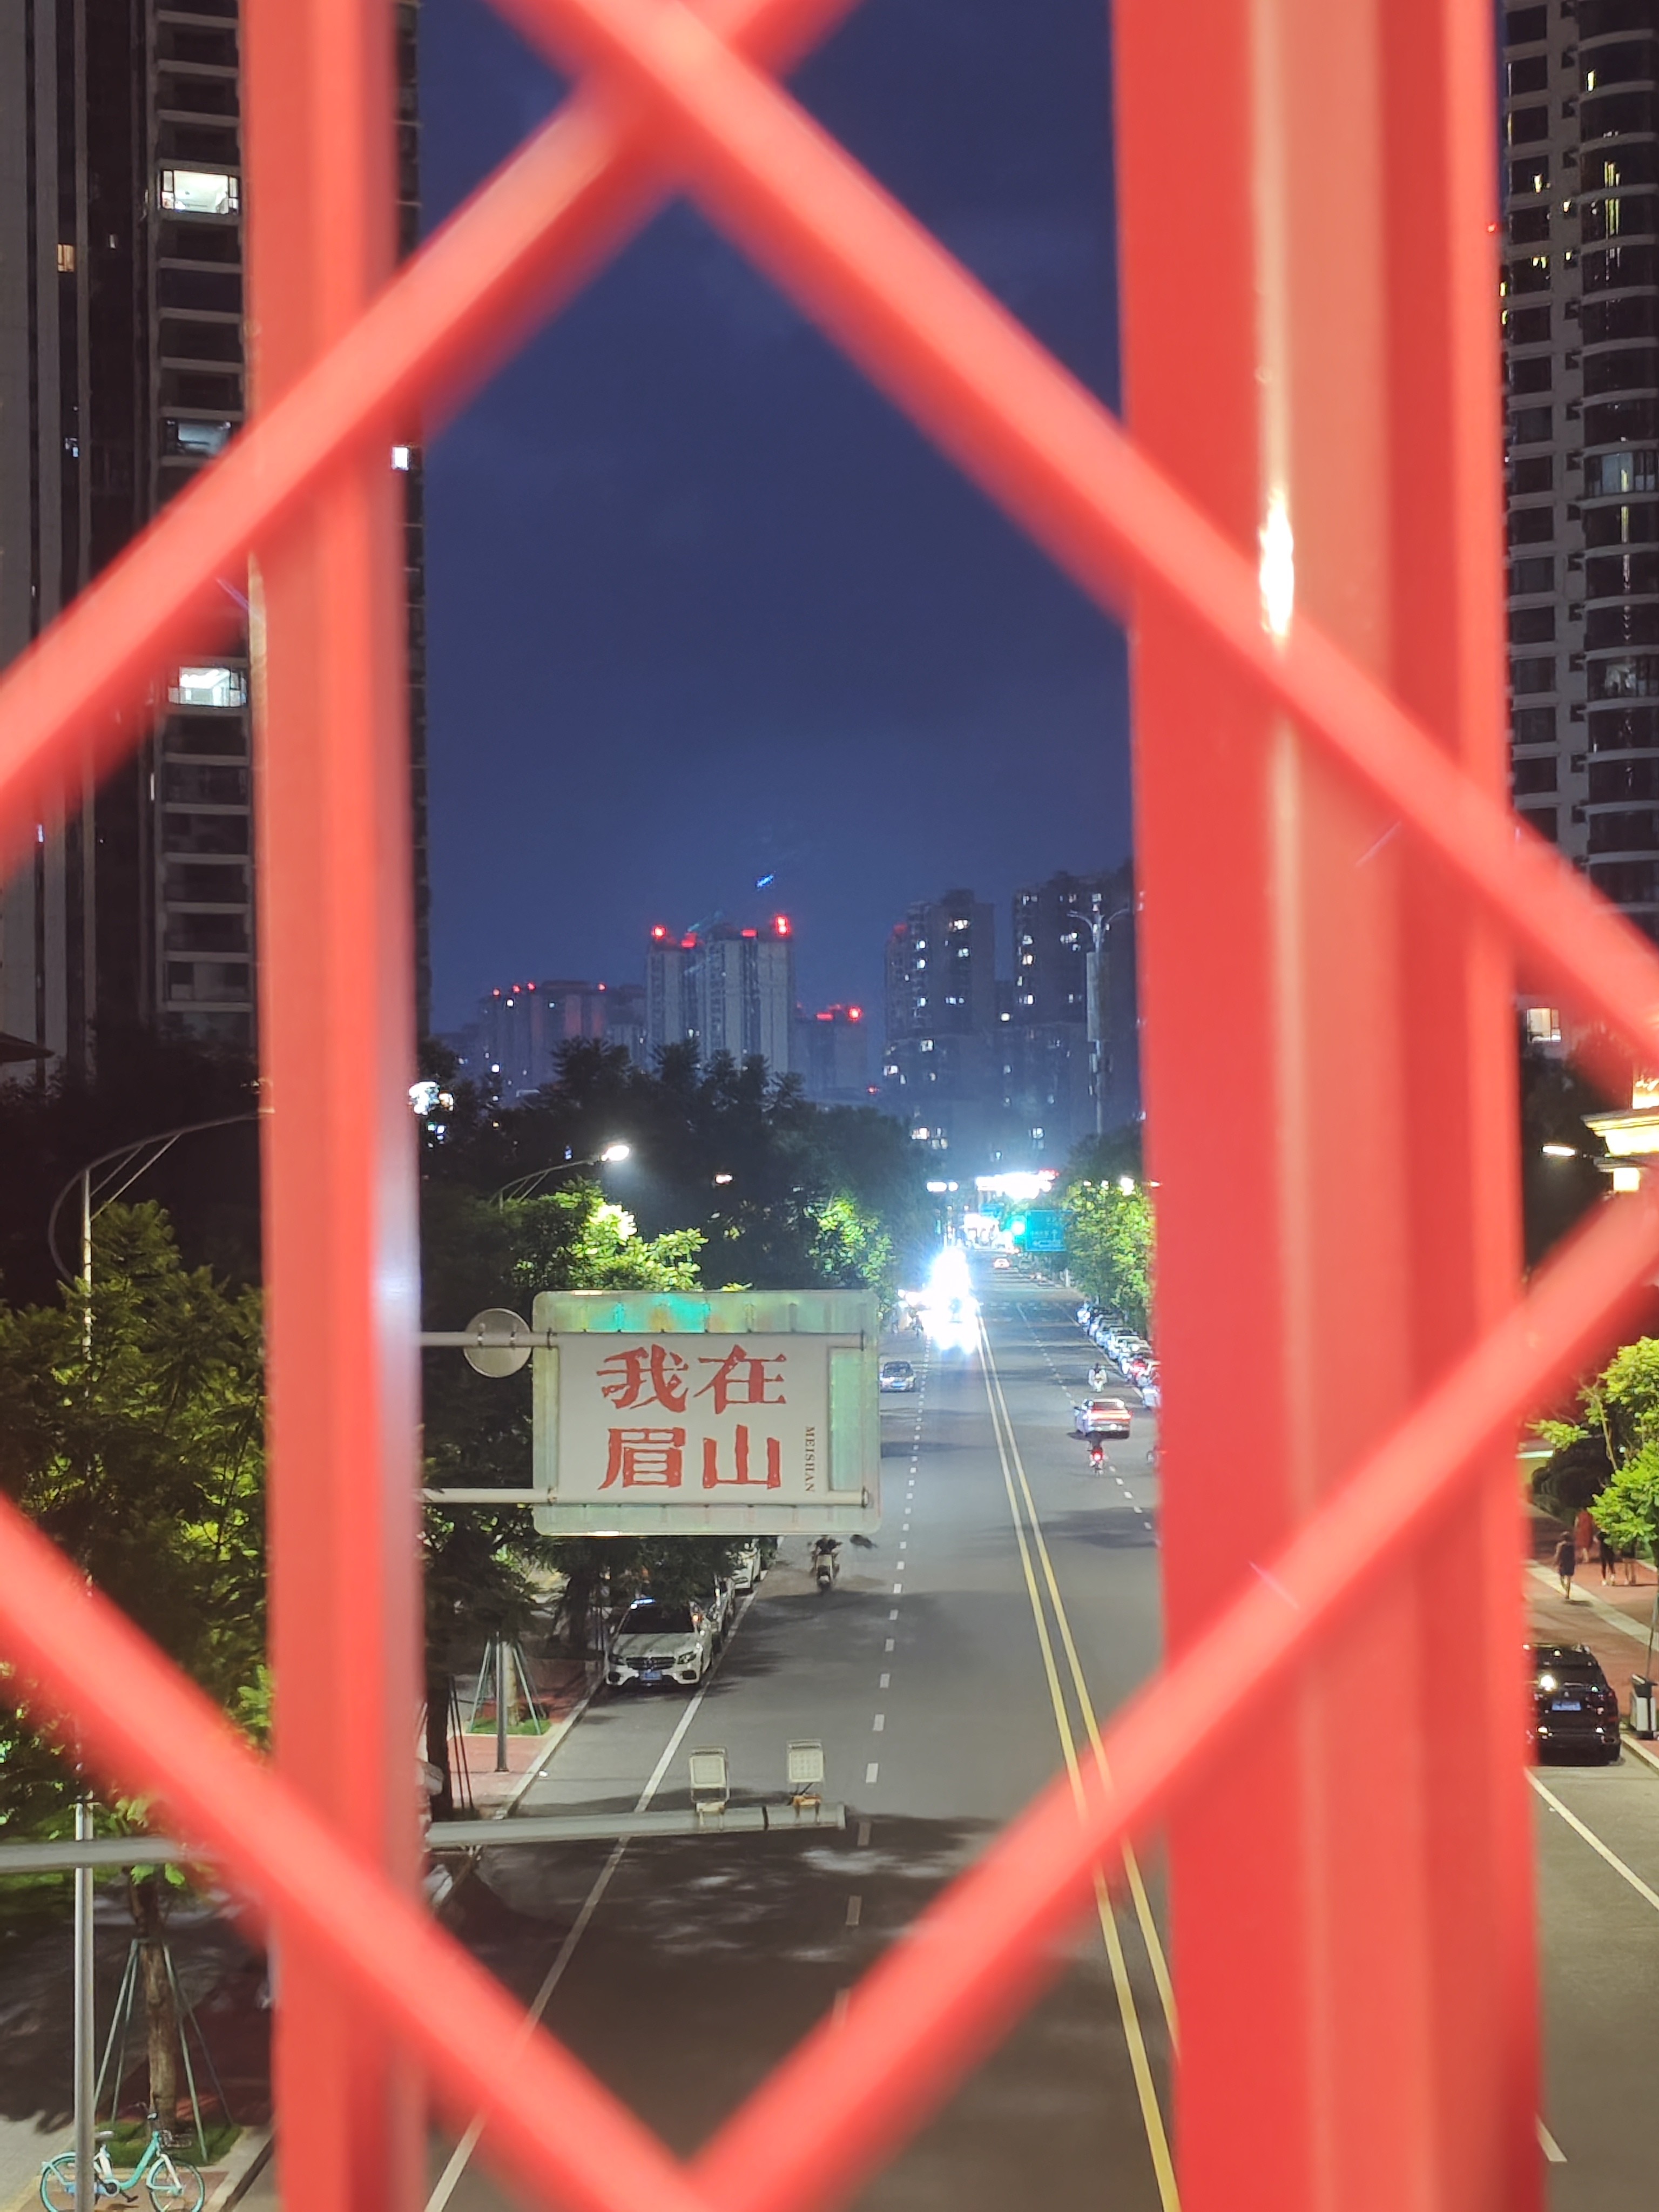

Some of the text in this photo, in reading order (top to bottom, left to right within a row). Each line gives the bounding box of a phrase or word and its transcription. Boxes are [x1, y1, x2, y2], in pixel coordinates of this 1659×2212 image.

[597, 1344, 787, 1414] 我在
[598, 1424, 781, 1490] 眉山
[805, 1426, 815, 1492] MEISHAN
